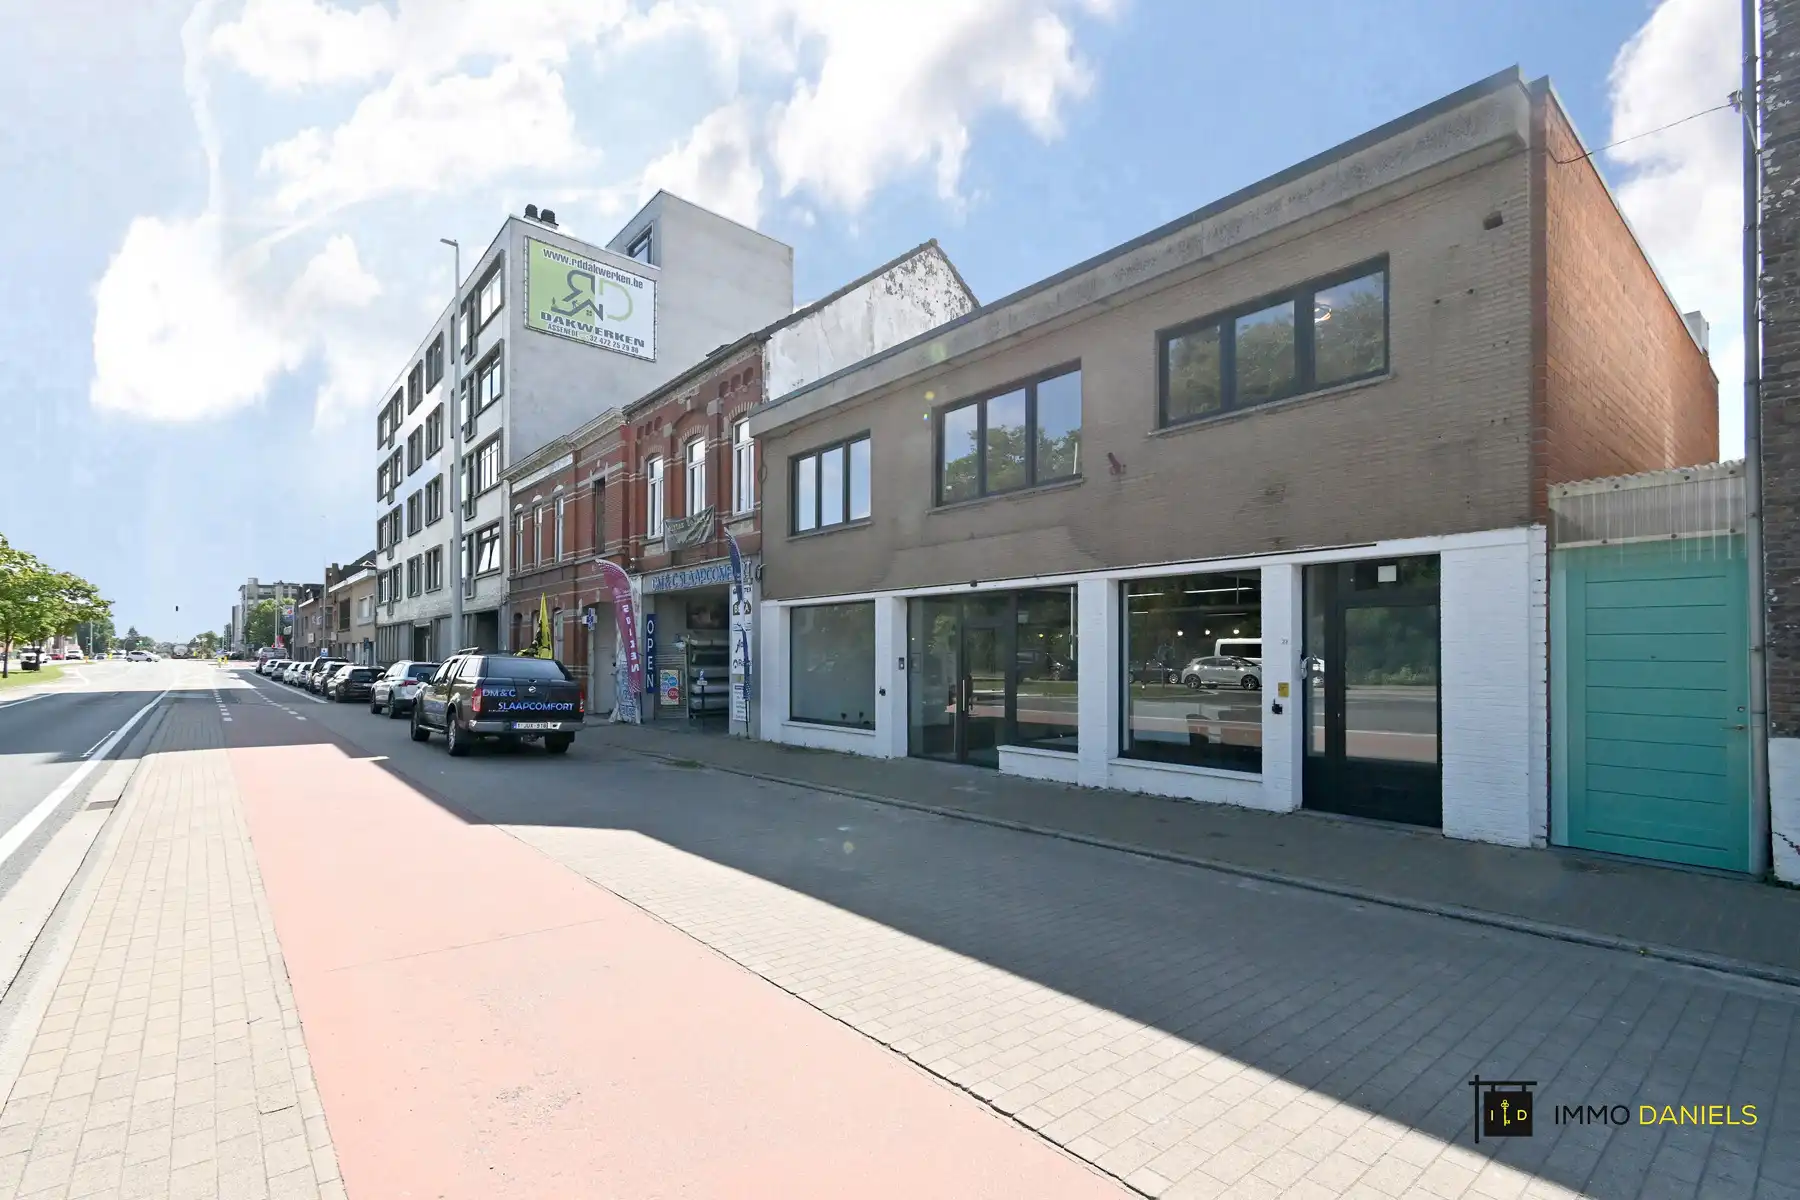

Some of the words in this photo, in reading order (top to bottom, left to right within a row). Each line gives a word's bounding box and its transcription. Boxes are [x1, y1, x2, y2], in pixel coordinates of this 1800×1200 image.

[543, 248, 643, 289] www.rddakwerken.be
[541, 311, 645, 348] DAKWERKEN
[547, 323, 578, 337] ASSENEDE
[646, 619, 655, 689] OPEN
[498, 701, 574, 711] SLAAPCOMFORT
